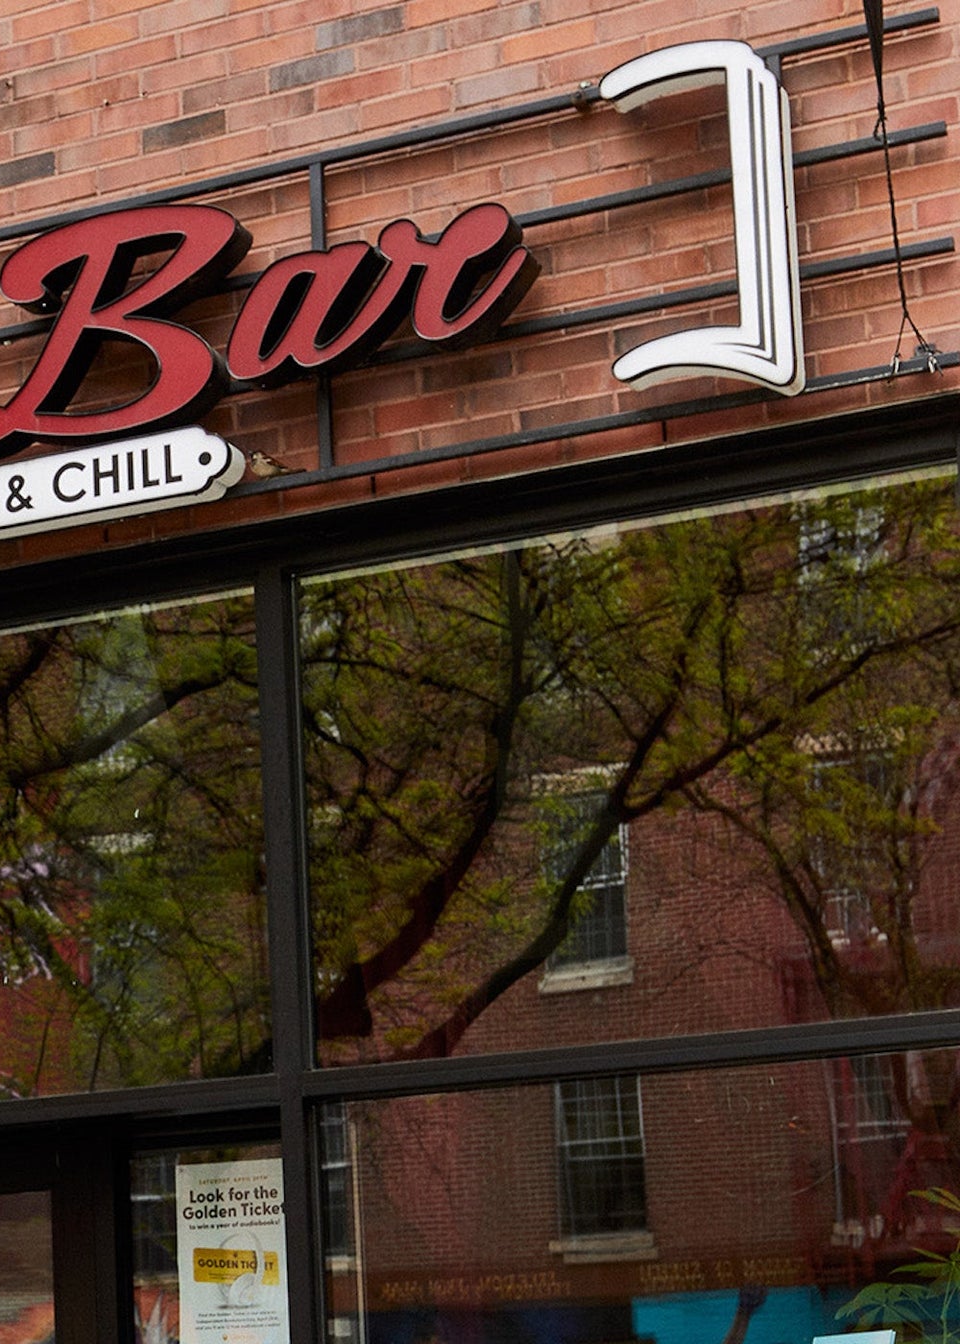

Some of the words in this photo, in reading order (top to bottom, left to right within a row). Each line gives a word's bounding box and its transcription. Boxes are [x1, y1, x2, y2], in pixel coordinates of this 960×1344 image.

[5, 475, 32, 512] &
[52, 445, 183, 503] CHILL
[189, 1188, 225, 1203] Look
[228, 1187, 250, 1201] for
[253, 1186, 278, 1200] the
[183, 1205, 237, 1220] Golden
[198, 1258, 238, 1269] GOLDEN
[241, 1261, 273, 1271] TICET
